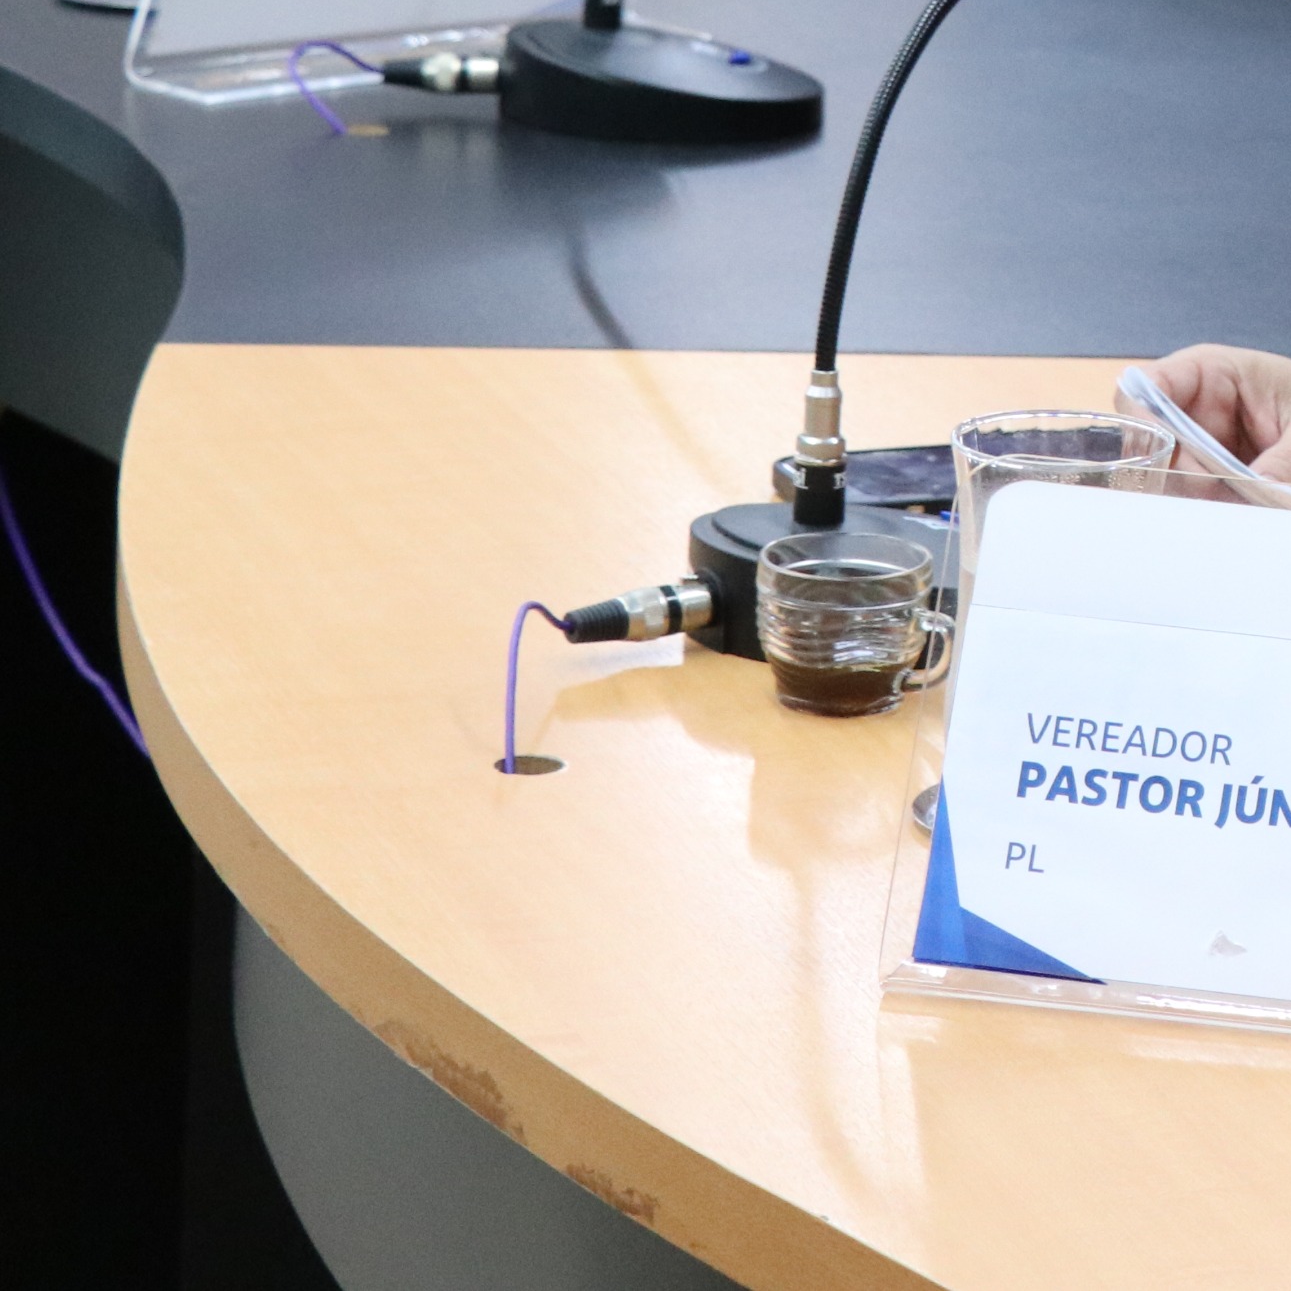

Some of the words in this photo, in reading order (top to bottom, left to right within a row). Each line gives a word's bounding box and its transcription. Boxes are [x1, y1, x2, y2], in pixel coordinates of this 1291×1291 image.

[1026, 712, 1233, 766] VEREADOR
[1015, 760, 1206, 819] PASTOR
[1004, 841, 1046, 874] PL
